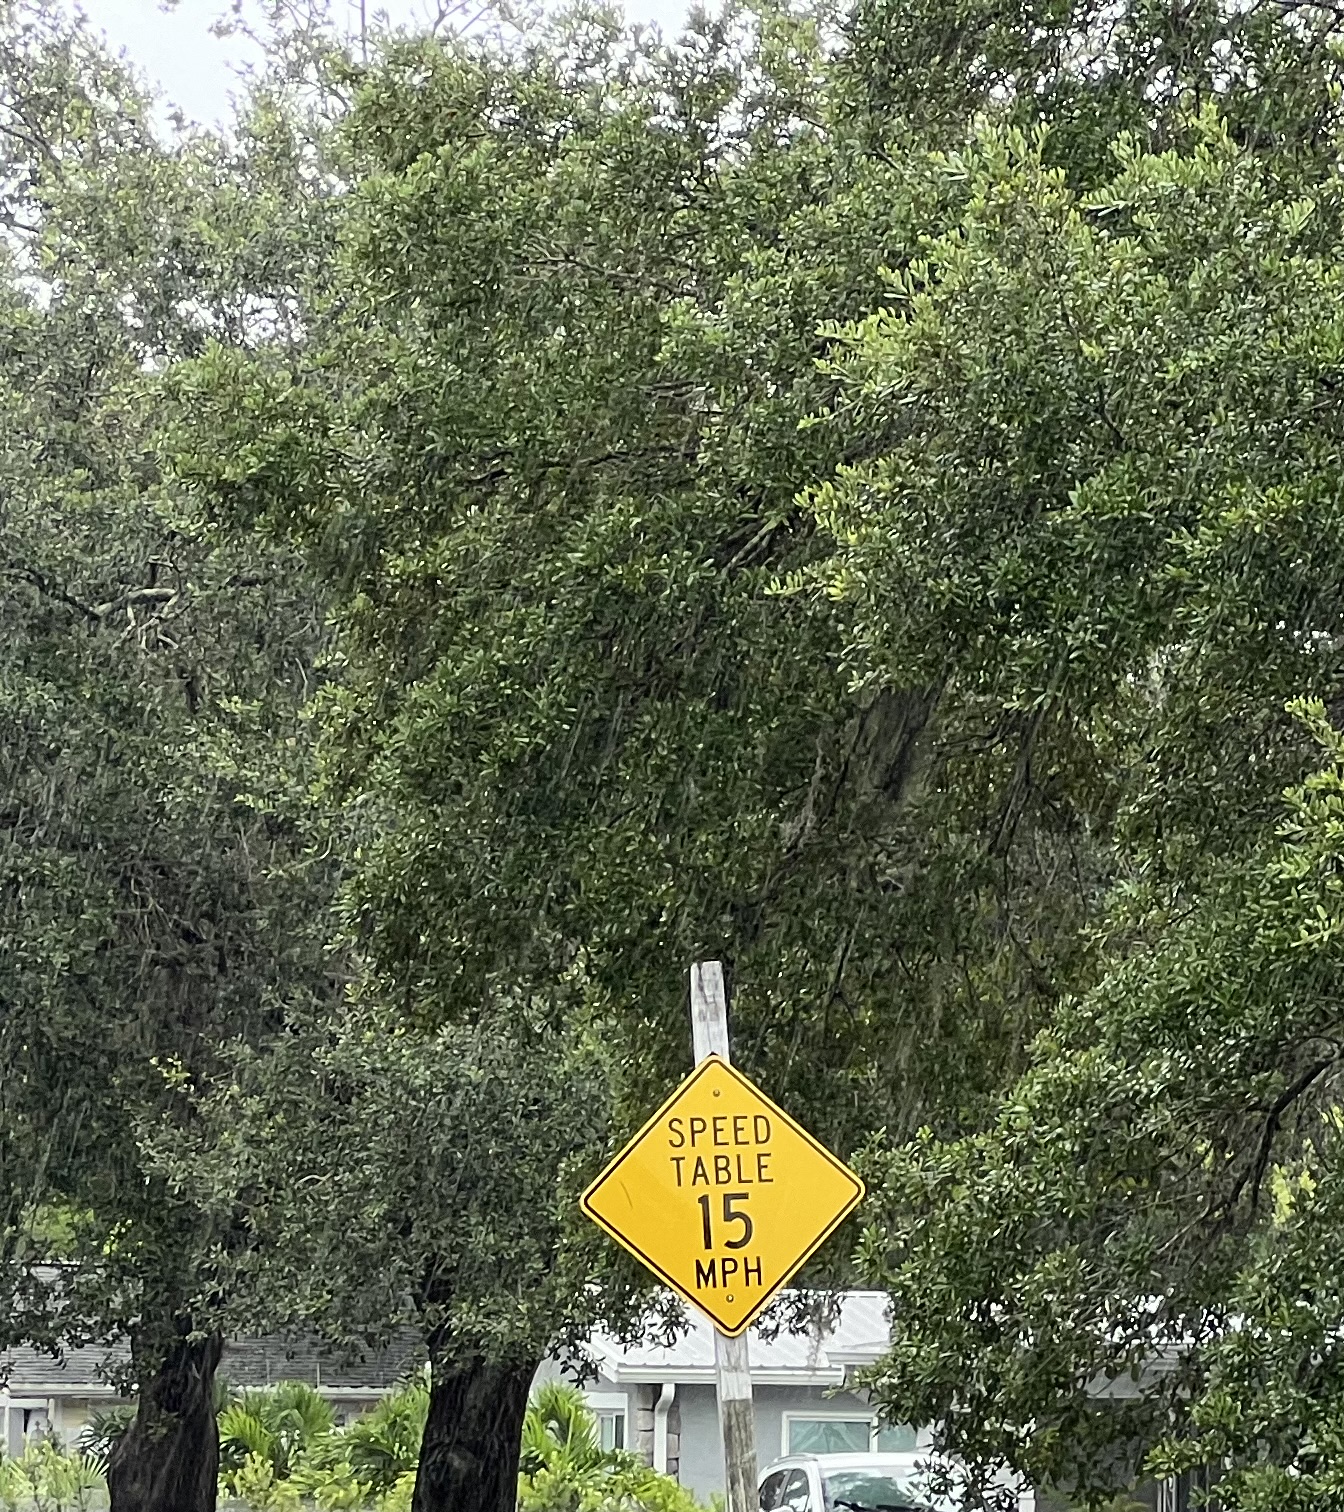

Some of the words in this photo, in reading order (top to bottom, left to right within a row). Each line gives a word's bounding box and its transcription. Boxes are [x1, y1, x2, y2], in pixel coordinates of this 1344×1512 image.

[668, 1114, 772, 1148] SPEED
[670, 1152, 774, 1187] TABLE
[697, 1192, 753, 1250] 15
[695, 1256, 762, 1290] MPH
